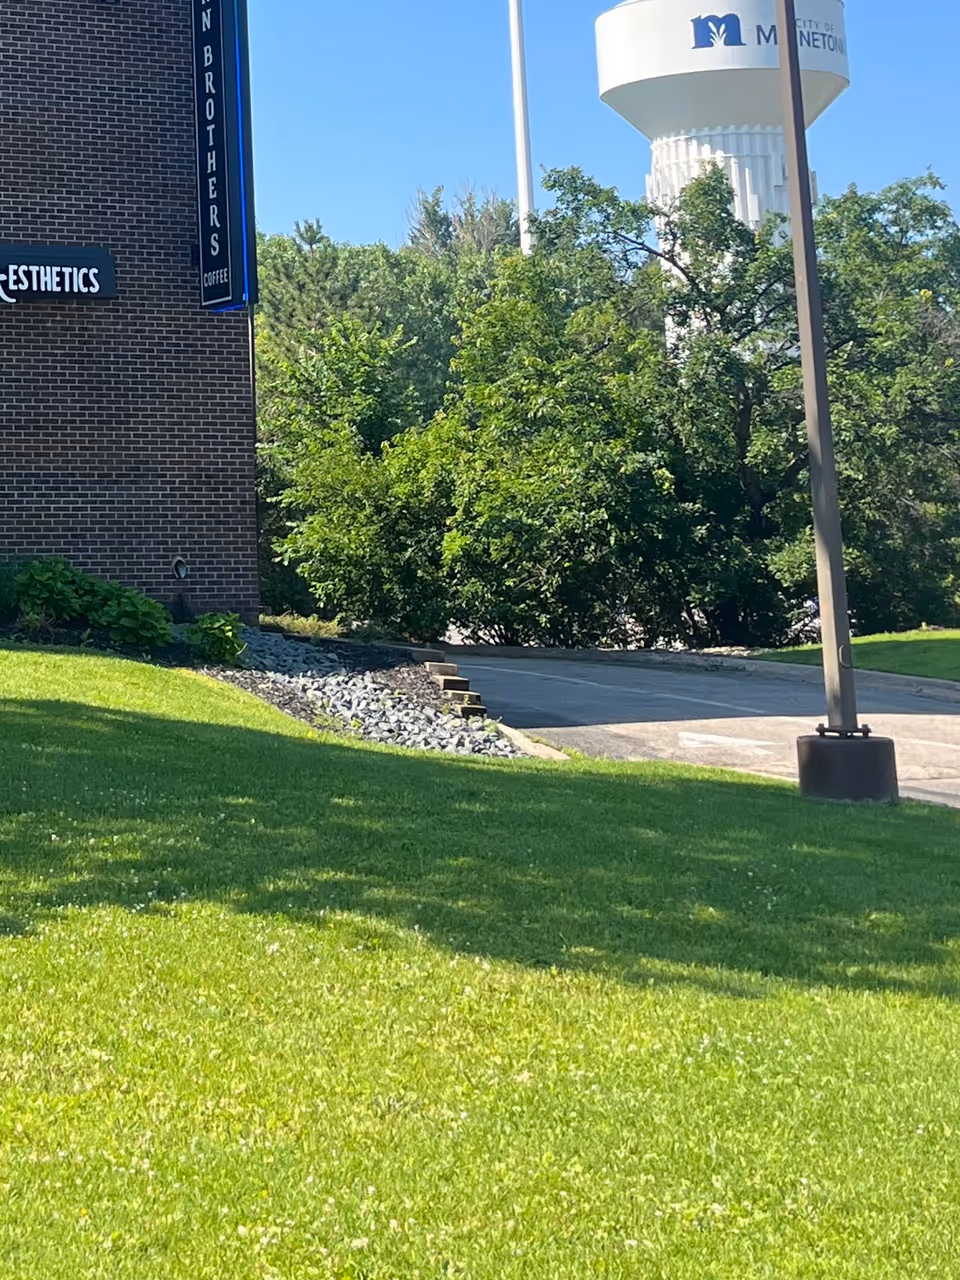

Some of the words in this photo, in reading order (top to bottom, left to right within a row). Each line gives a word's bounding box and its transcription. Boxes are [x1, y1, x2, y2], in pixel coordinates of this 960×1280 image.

[794, 17, 820, 30] CITY
[824, 22, 836, 33] OF
[203, 45, 221, 257] BROTHERS
[203, 267, 229, 287] COFFEE
